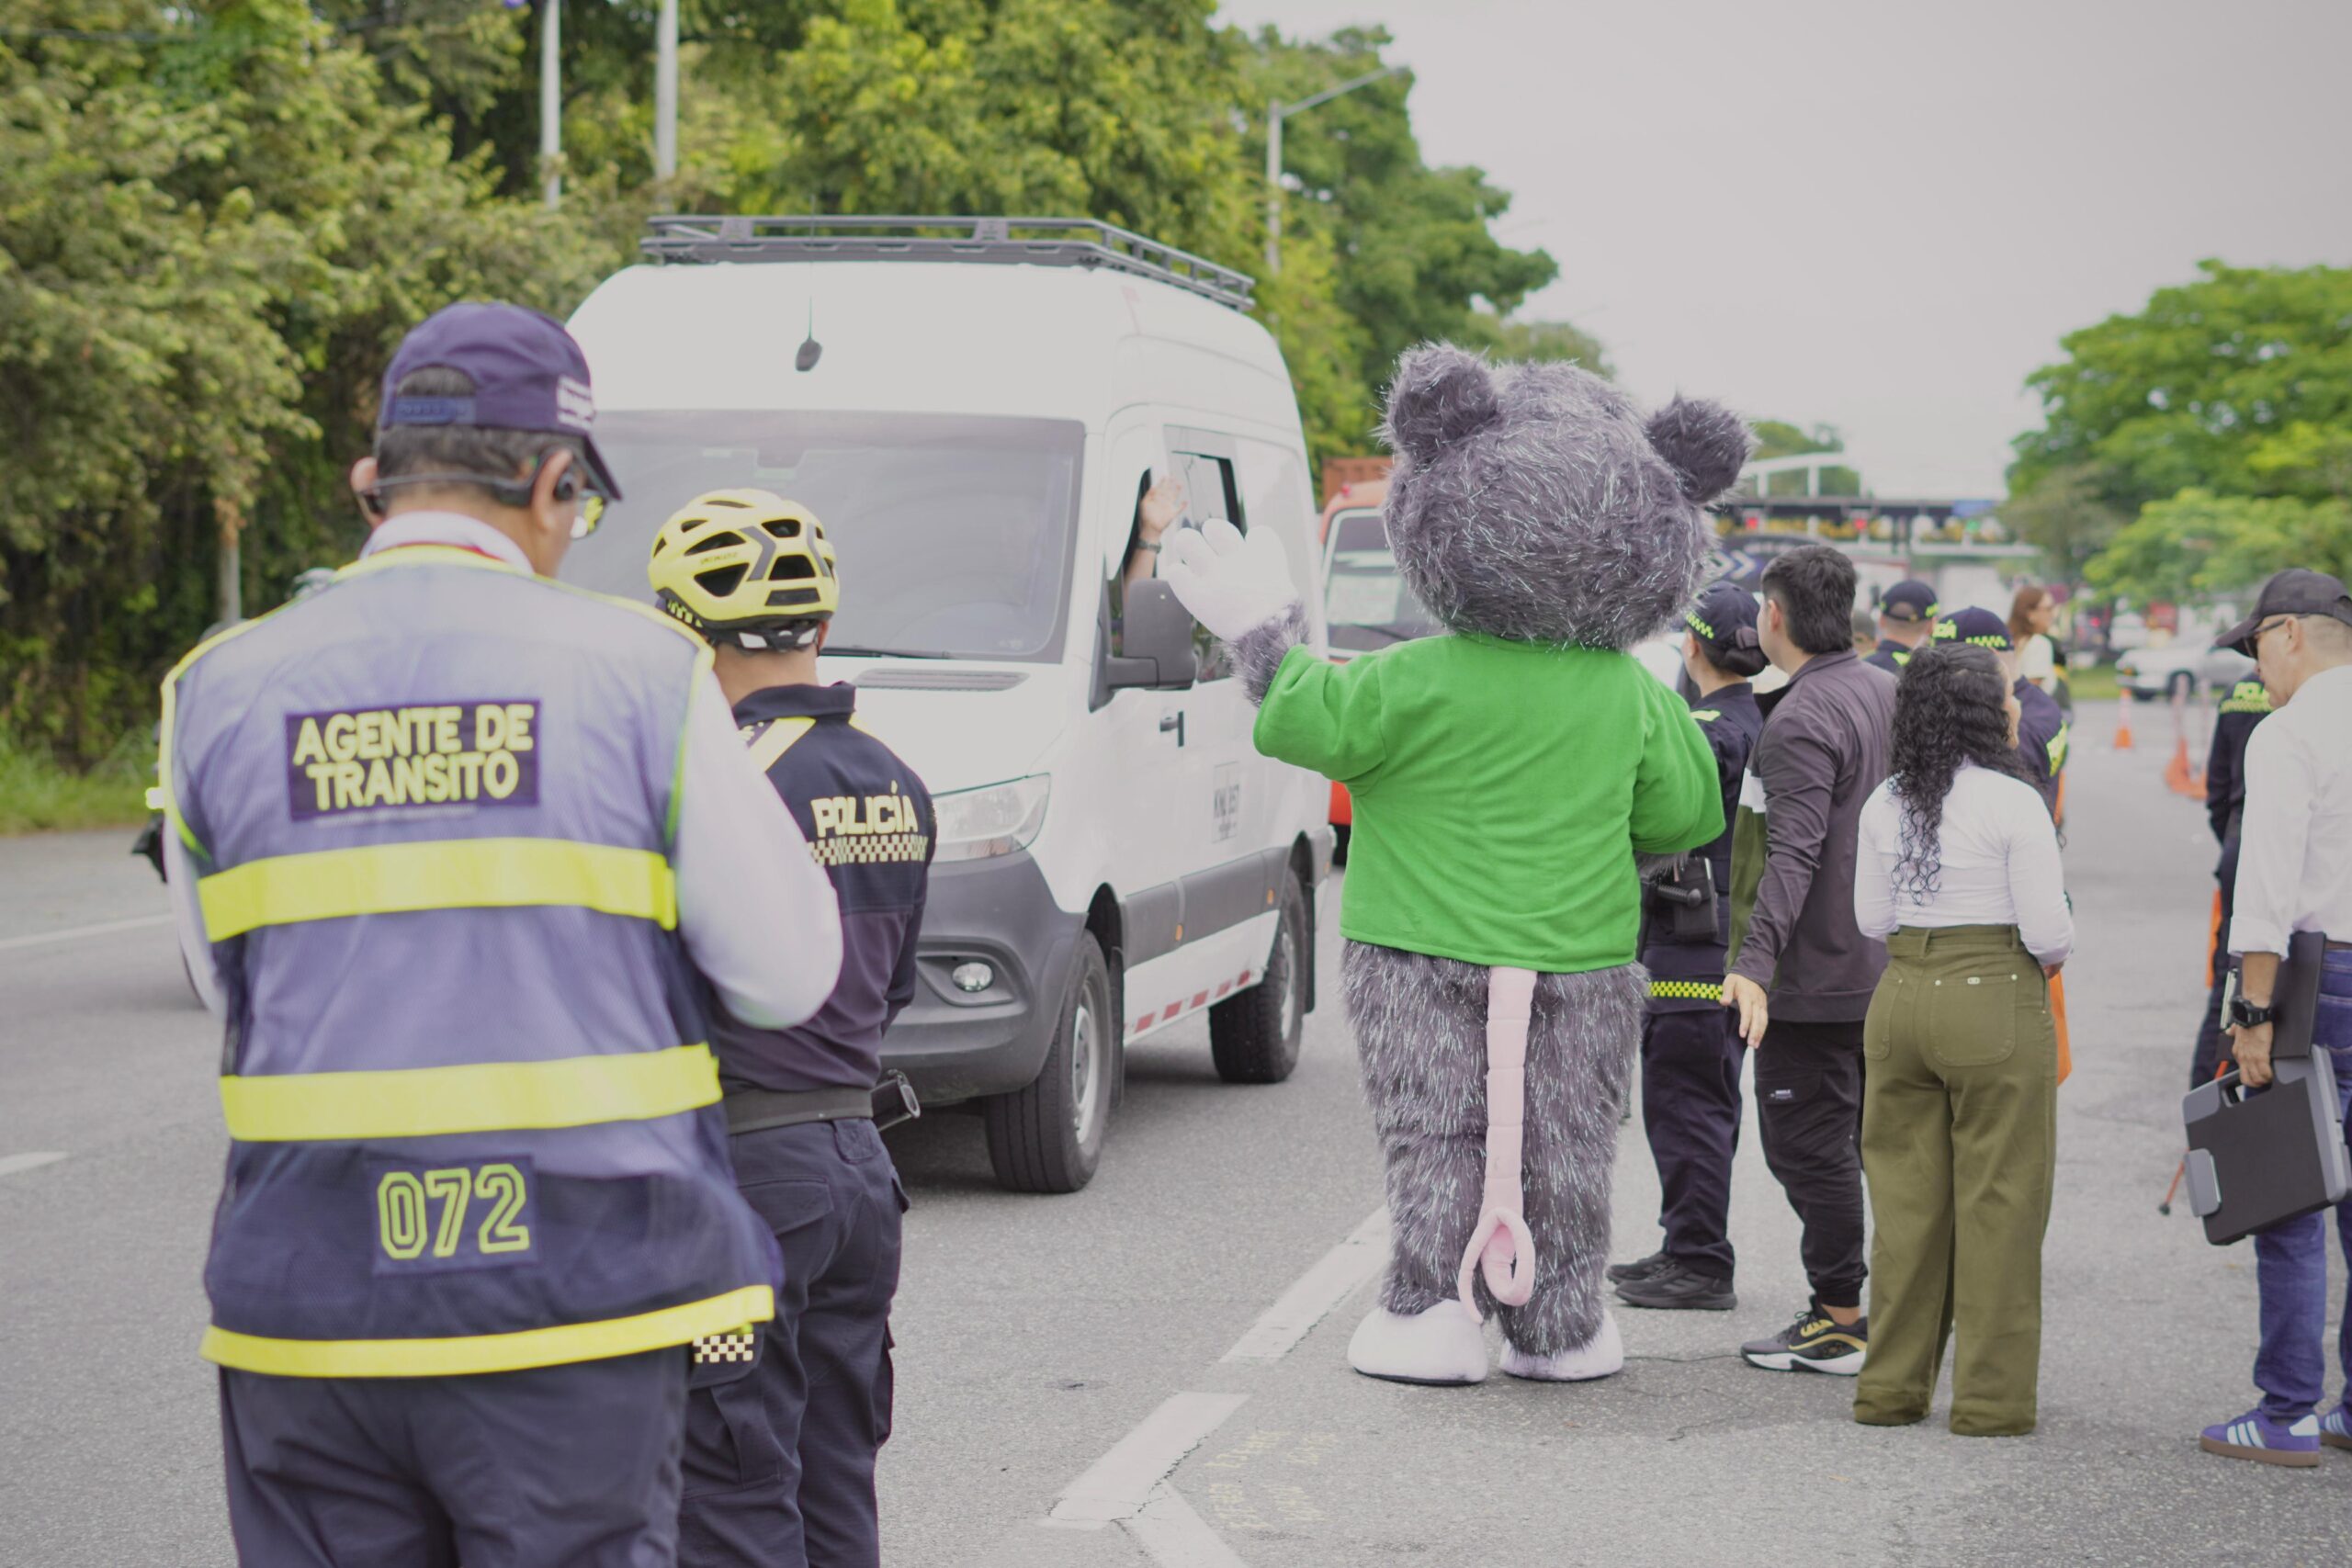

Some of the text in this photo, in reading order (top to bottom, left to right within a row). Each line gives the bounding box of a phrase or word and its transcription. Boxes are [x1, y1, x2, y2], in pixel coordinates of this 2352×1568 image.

[293, 704, 535, 766] AGENTE DE
[306, 749, 519, 811] TRANSITO
[810, 780, 919, 838] POLICÍA
[377, 1163, 530, 1260] 072
